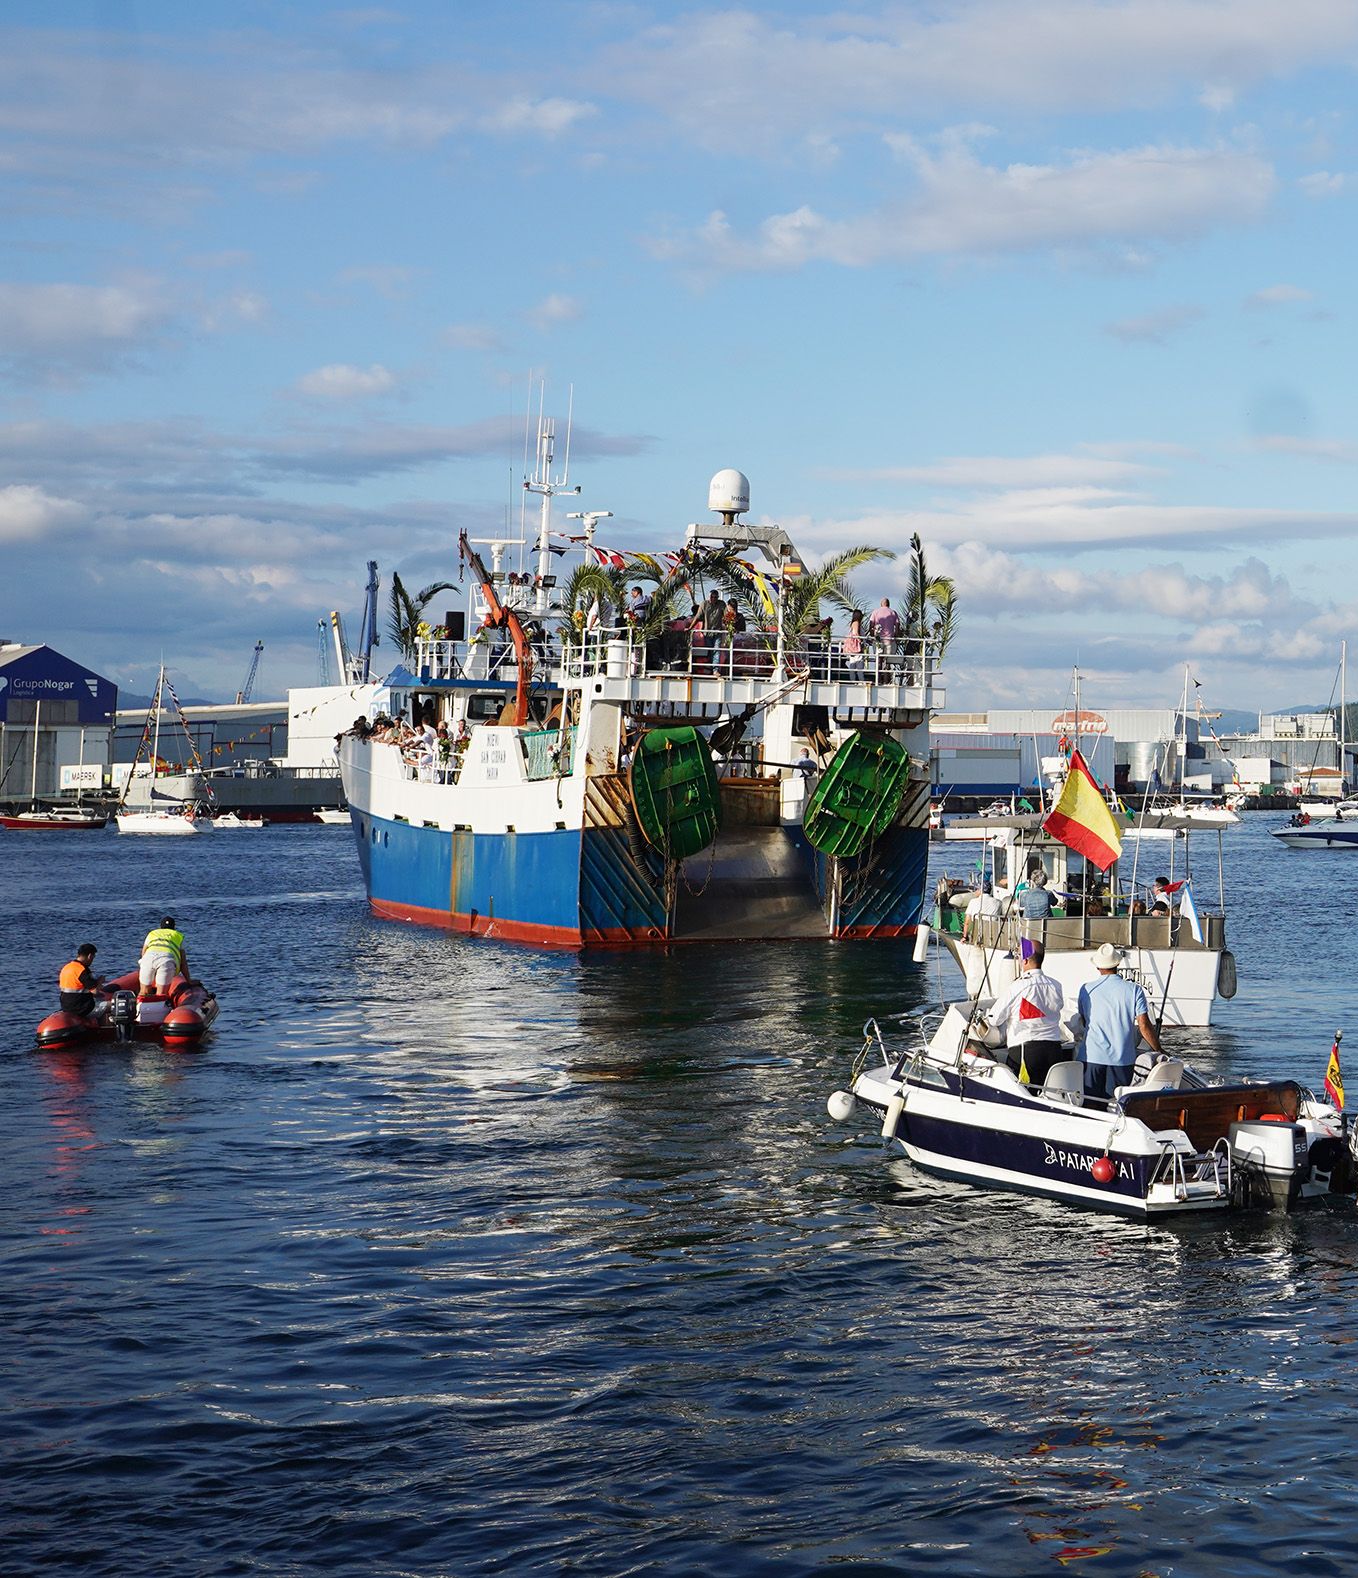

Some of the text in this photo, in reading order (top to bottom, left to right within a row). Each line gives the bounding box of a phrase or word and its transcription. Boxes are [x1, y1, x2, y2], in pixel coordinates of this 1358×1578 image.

[13, 678, 74, 691] GrupoNogar
[71, 771, 96, 781] MAERSK
[1295, 1143, 1307, 1153] 55
